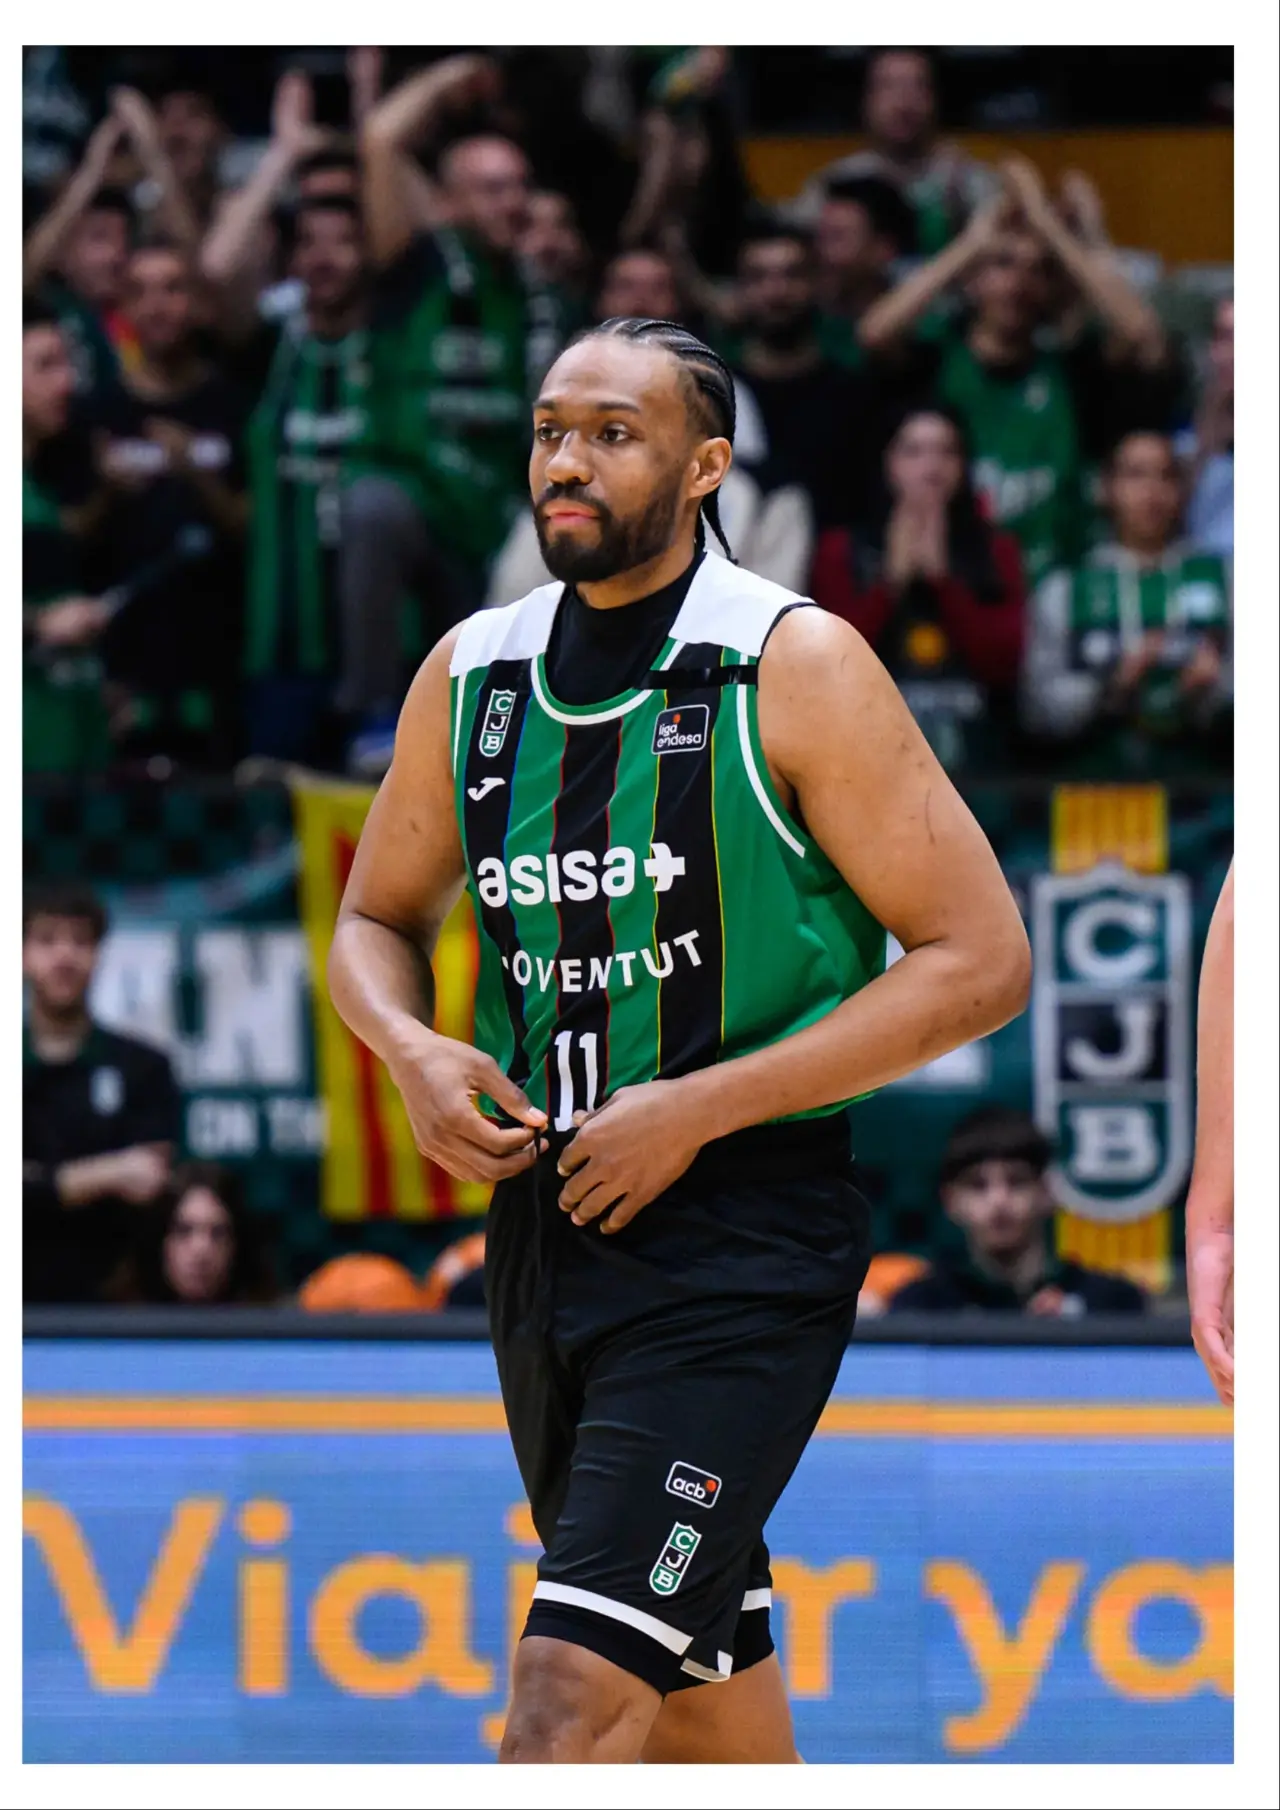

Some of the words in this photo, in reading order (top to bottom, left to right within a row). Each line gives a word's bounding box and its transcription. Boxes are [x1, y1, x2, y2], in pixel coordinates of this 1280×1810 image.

[656, 732, 702, 749] endesa
[658, 722, 678, 737] liga
[501, 929, 702, 993] OVENTUT
[554, 1030, 598, 1133] 11
[672, 1477, 706, 1500] acb
[23, 1500, 872, 1750] Viar
